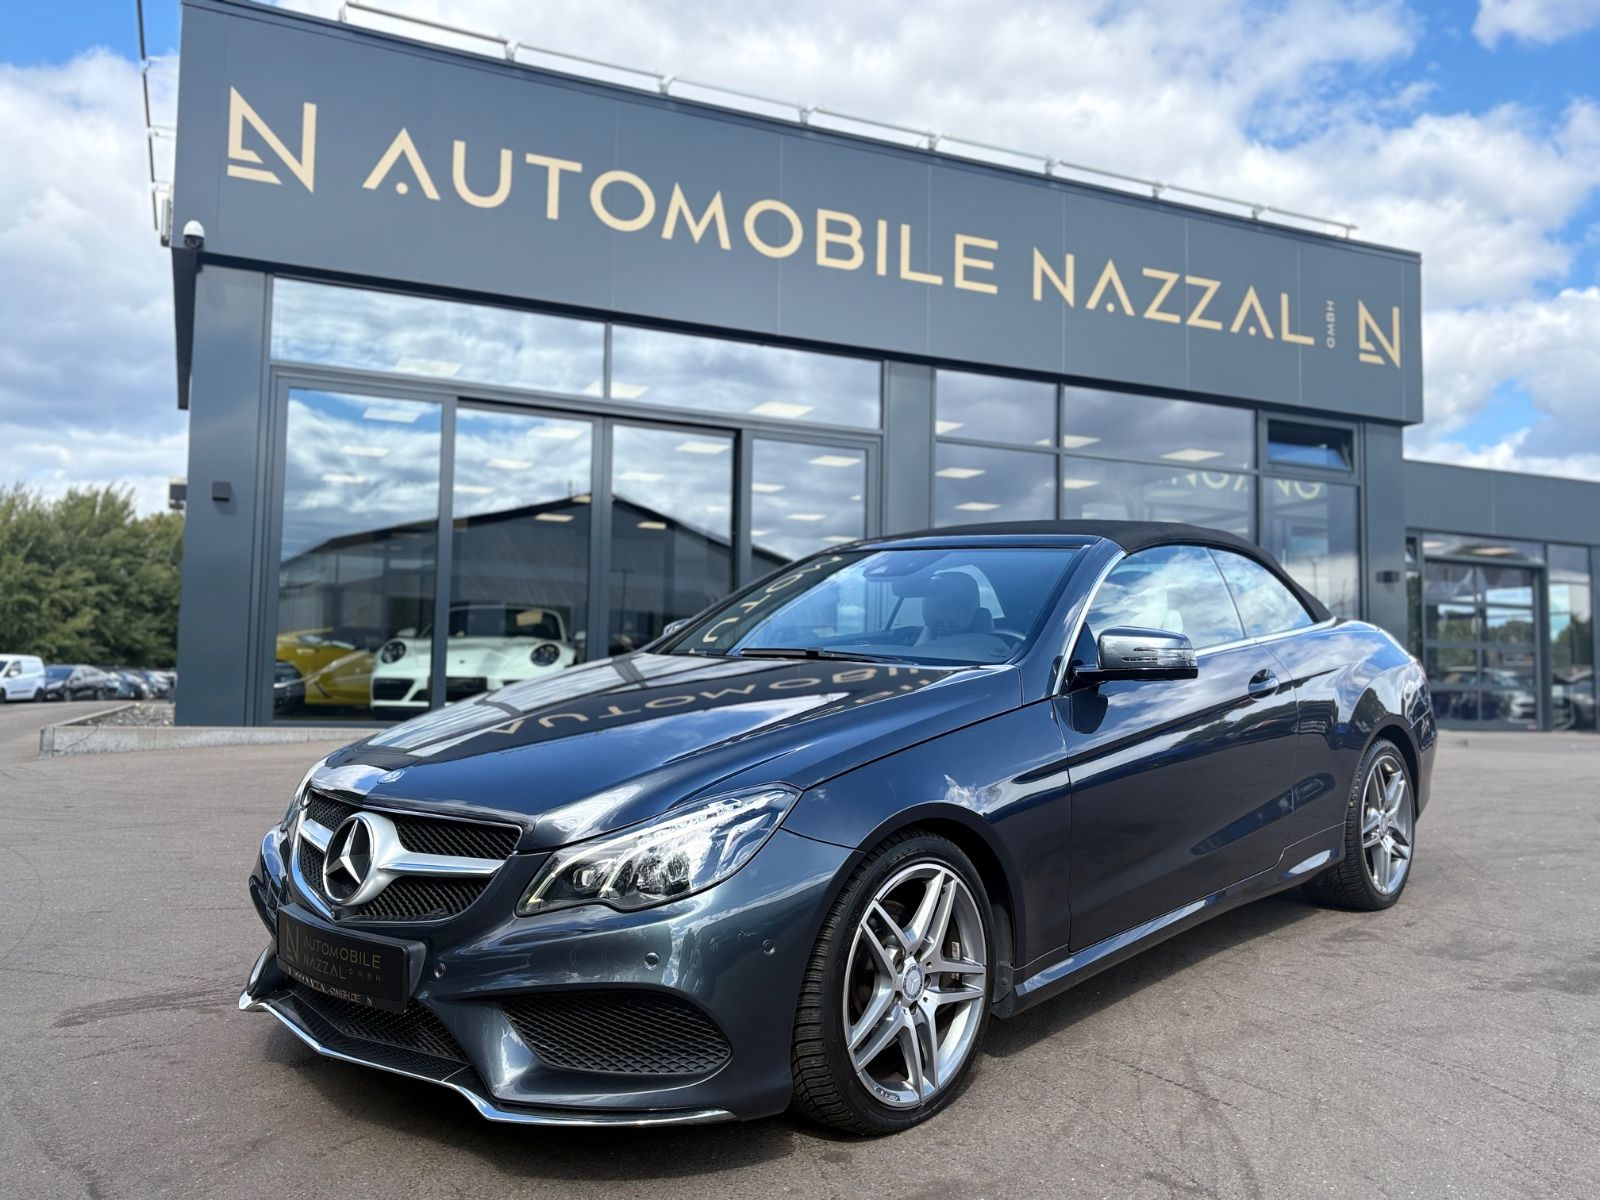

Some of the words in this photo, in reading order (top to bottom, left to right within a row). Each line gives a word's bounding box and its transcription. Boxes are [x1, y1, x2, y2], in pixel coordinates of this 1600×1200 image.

[362, 127, 999, 295] AUTOMOBILE
[1032, 246, 1315, 346] NAZZAL
[303, 936, 383, 969] AUTOMOBILE
[303, 954, 347, 980] NAZZAL
